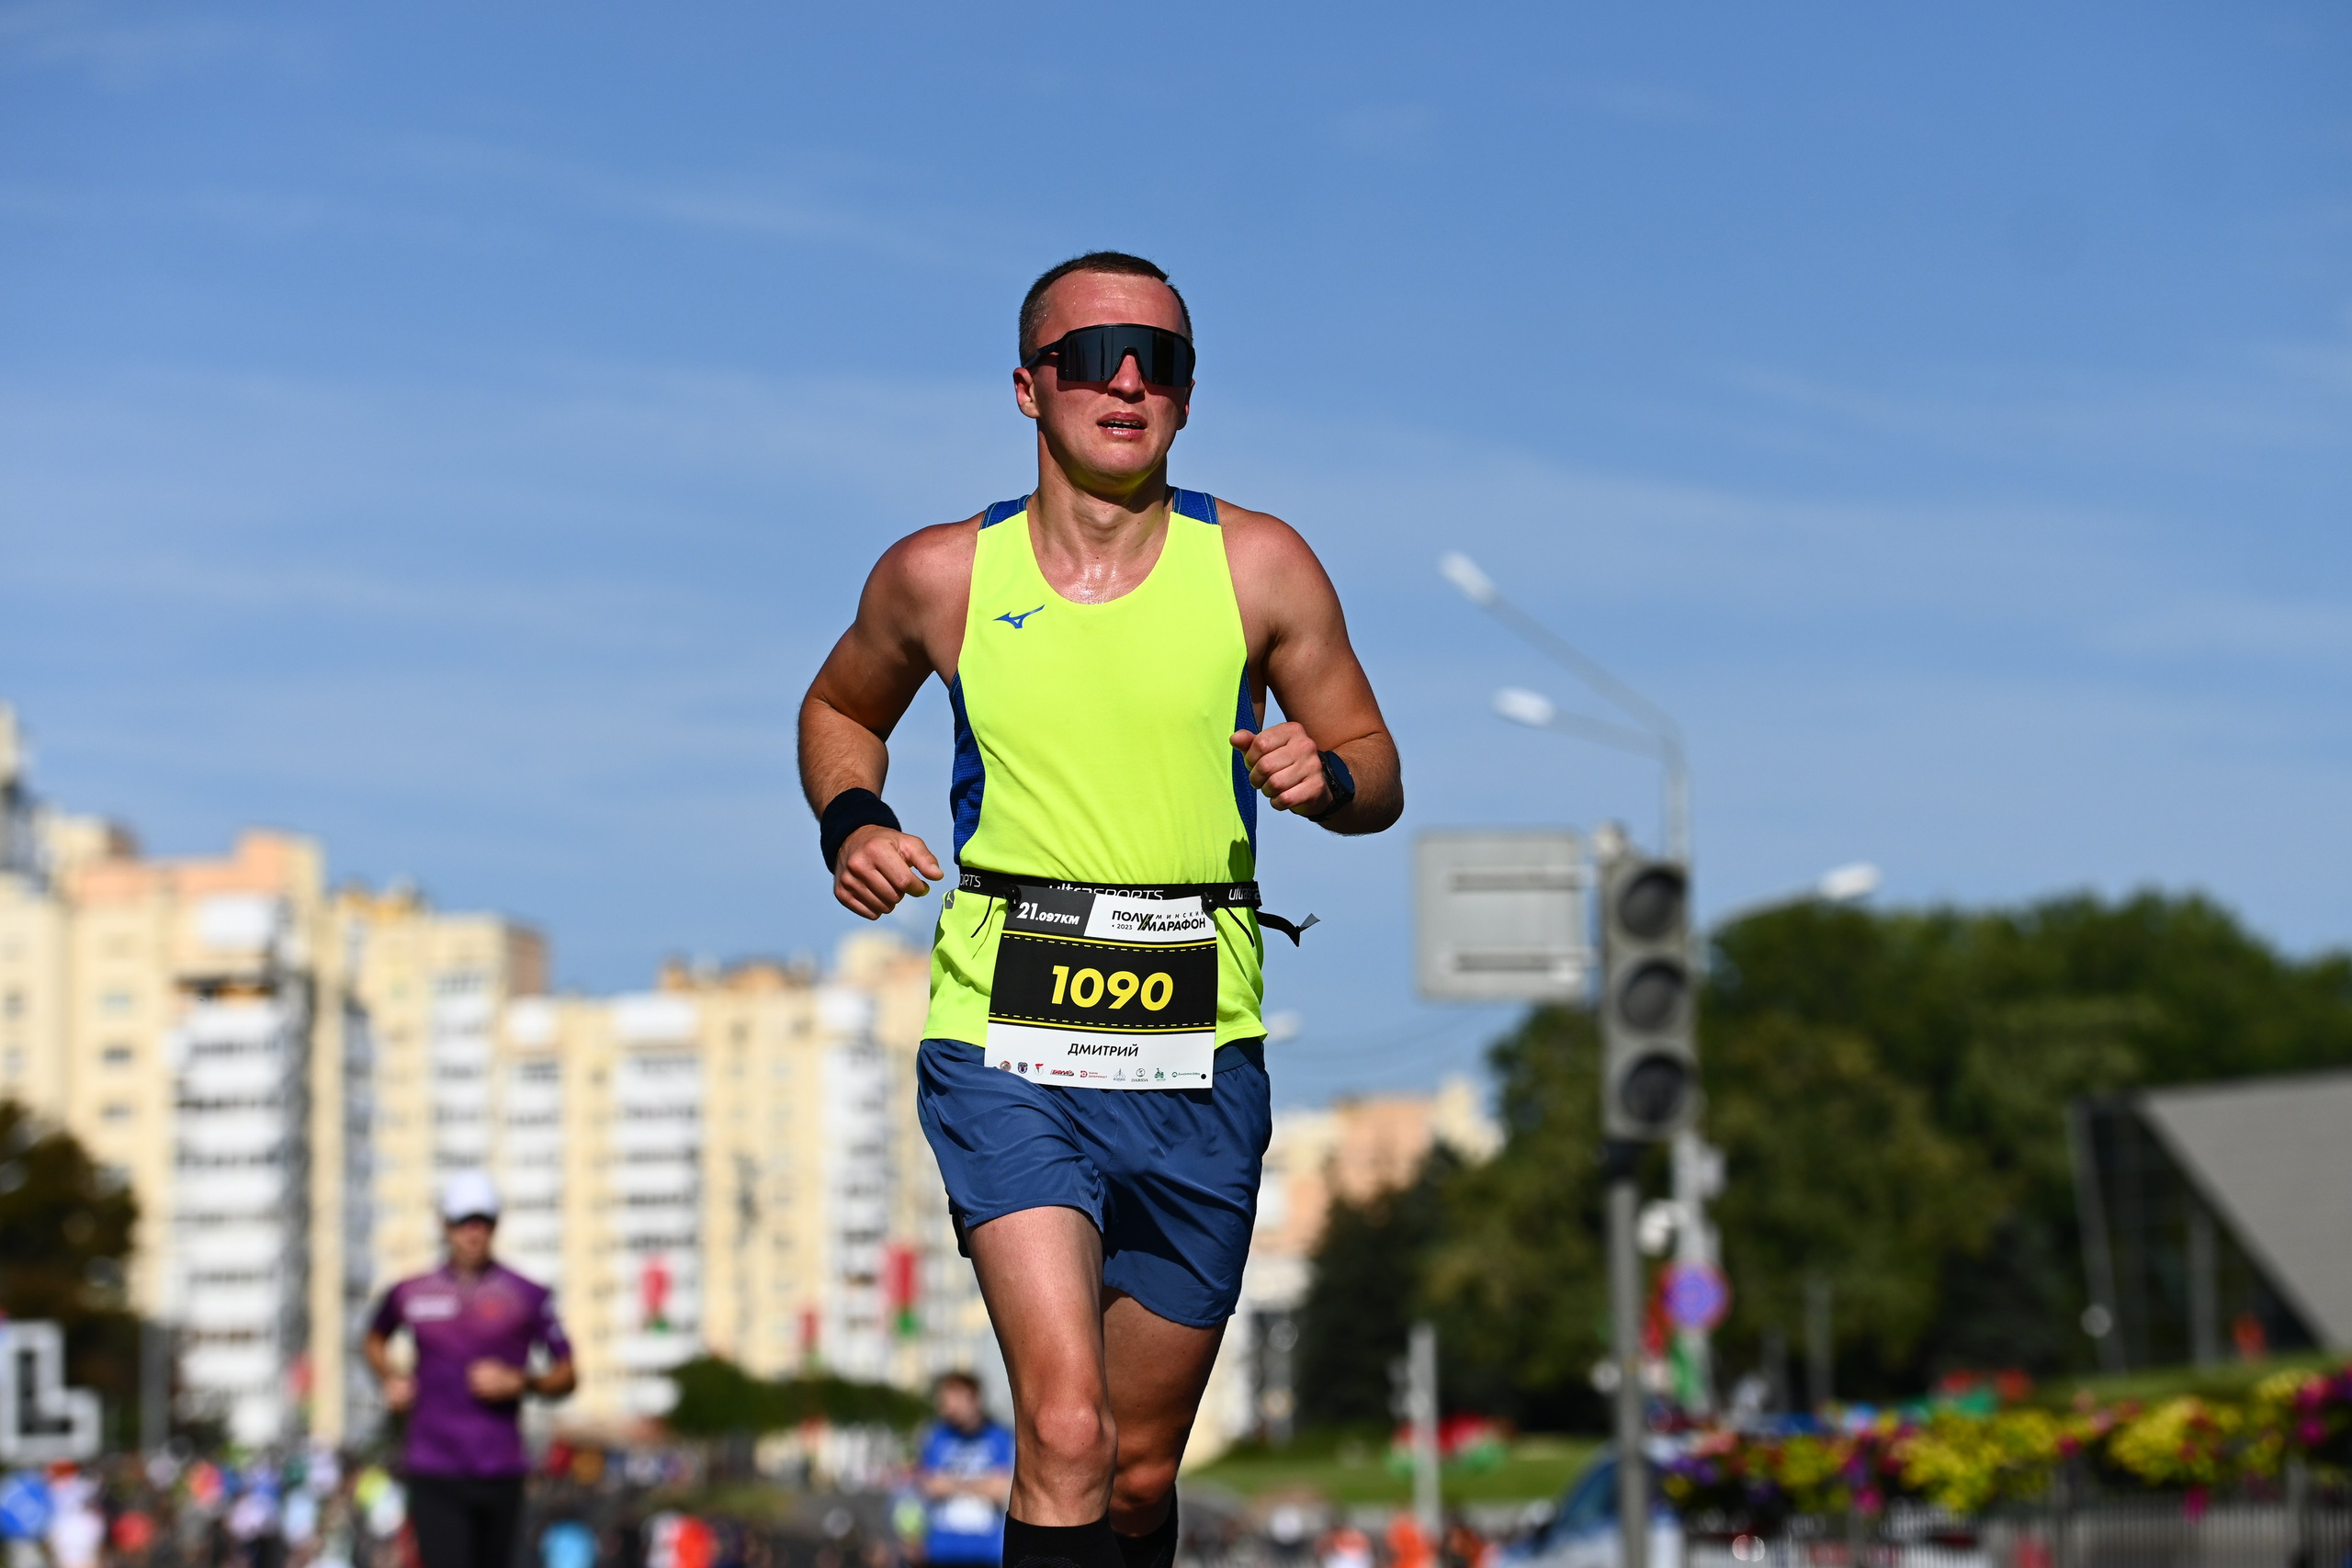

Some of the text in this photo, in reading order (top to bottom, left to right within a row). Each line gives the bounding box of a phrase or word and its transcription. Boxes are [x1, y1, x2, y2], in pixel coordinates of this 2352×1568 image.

[1145, 918, 1206, 931] МАРАФОН
[1051, 964, 1174, 1011] 1090
[1068, 1043, 1139, 1057] ДМИТРИЙ
